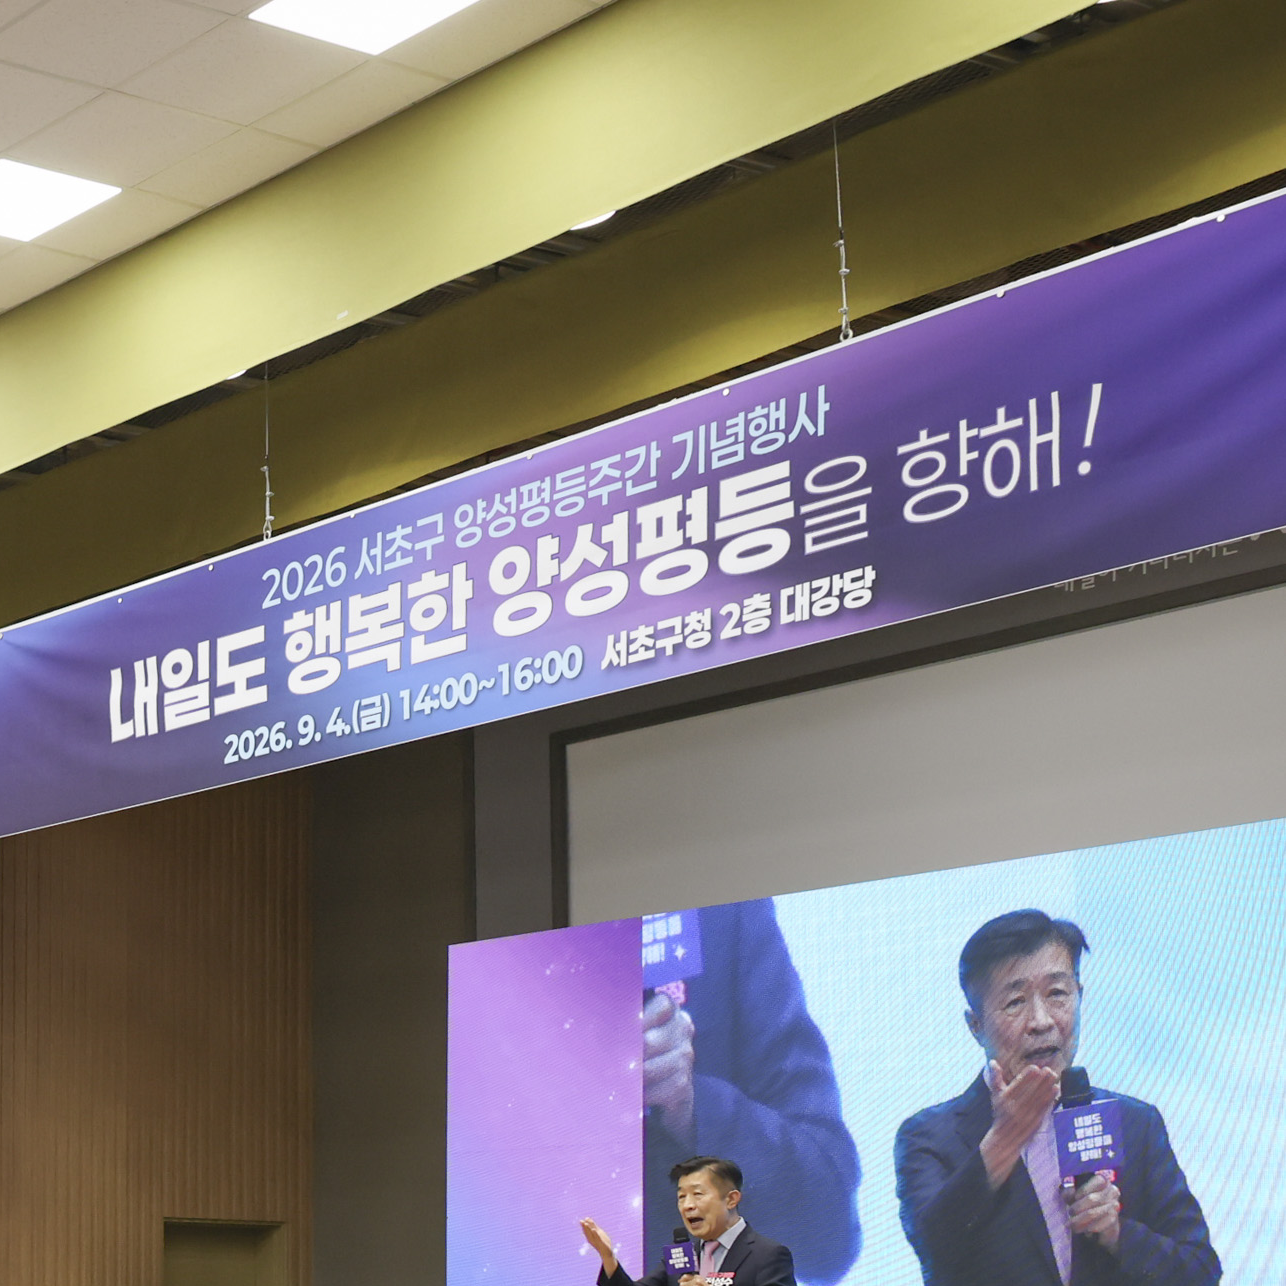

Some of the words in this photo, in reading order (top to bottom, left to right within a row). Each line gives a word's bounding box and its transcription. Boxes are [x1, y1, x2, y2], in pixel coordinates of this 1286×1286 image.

[108, 624, 268, 744] 내일도
[283, 561, 473, 695] 행복한
[488, 454, 874, 639] 양성평등을
[895, 383, 1103, 525] 향해!
[261, 546, 347, 609] 2026
[354, 511, 446, 580] 서초구
[453, 448, 661, 549] 양성평등주간
[671, 384, 830, 481] 기념행사
[223, 722, 293, 765] 2026.
[297, 714, 322, 748] 9.
[399, 643, 584, 721] 14:00~16:00
[600, 607, 713, 671] 서초구청
[719, 592, 772, 642] 2층
[779, 565, 876, 628] 대강당
